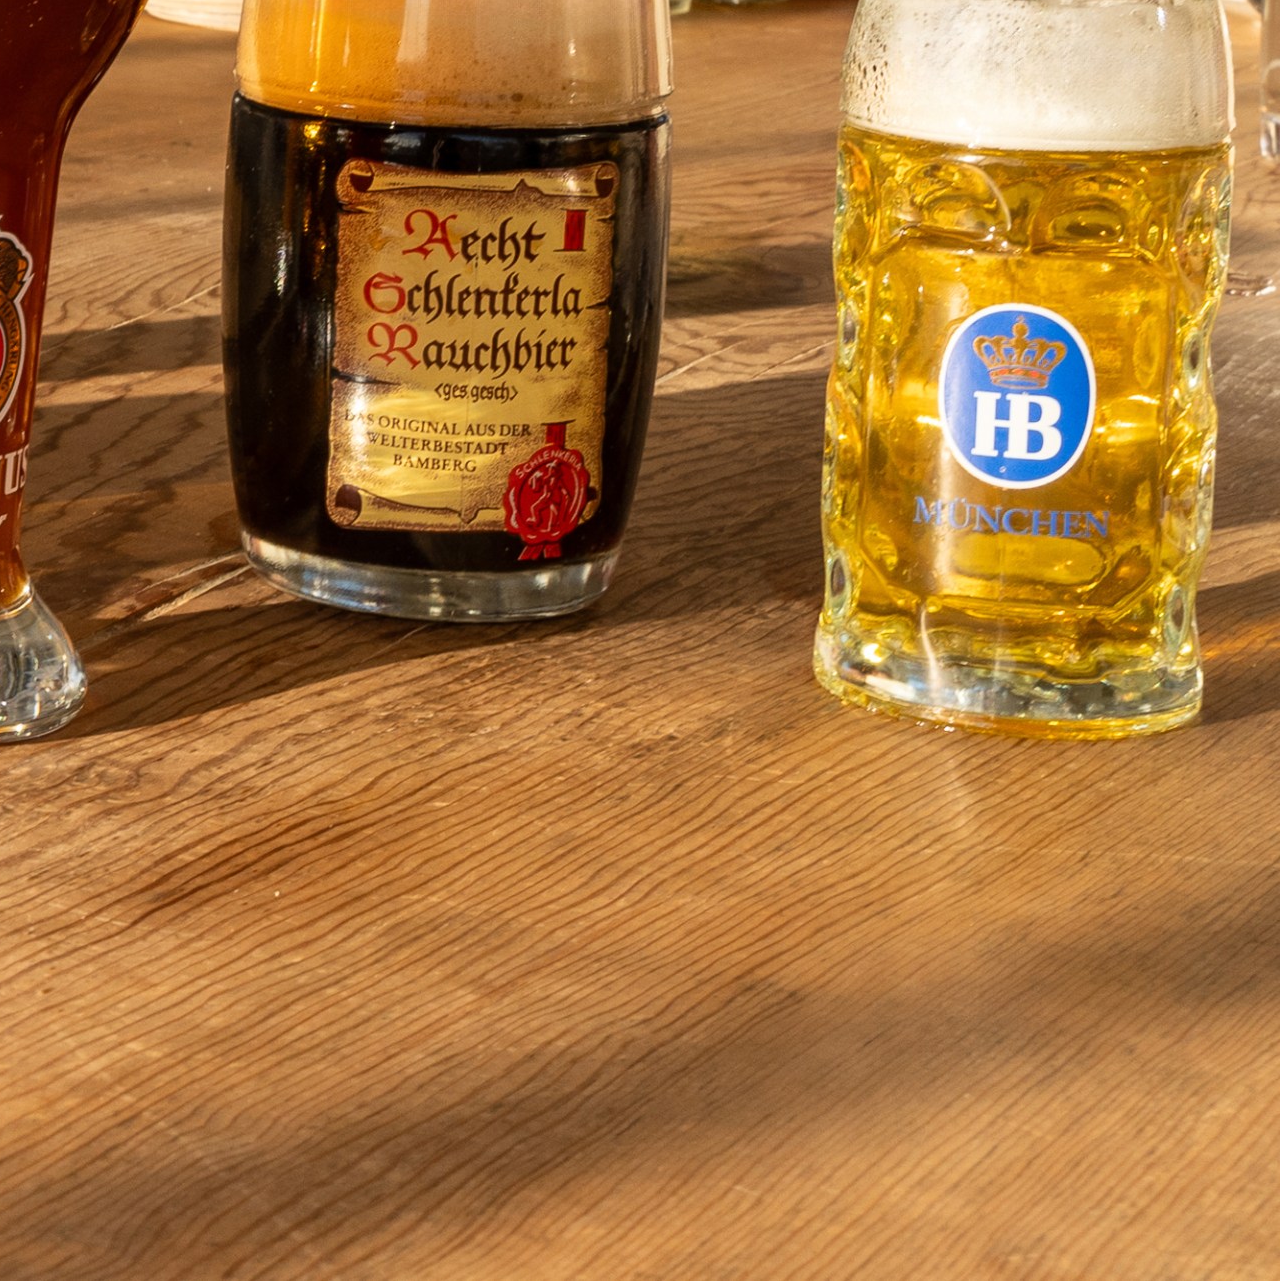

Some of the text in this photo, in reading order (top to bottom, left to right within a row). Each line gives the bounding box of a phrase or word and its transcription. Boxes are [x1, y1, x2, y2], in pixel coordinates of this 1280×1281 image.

[402, 208, 547, 271] Aecht
[363, 270, 584, 324] Schlenkerla
[366, 322, 578, 380] Rauchbier
[367, 432, 509, 456] WELTERBESTADT
[378, 415, 461, 436] ORIGINAL
[465, 423, 497, 437] AUS
[499, 423, 533, 438] DER
[971, 390, 1063, 461] HB
[392, 454, 478, 474] BAMBERG
[514, 448, 584, 479] SCHLENKERLA
[912, 495, 1110, 539] MÜNCHEN
